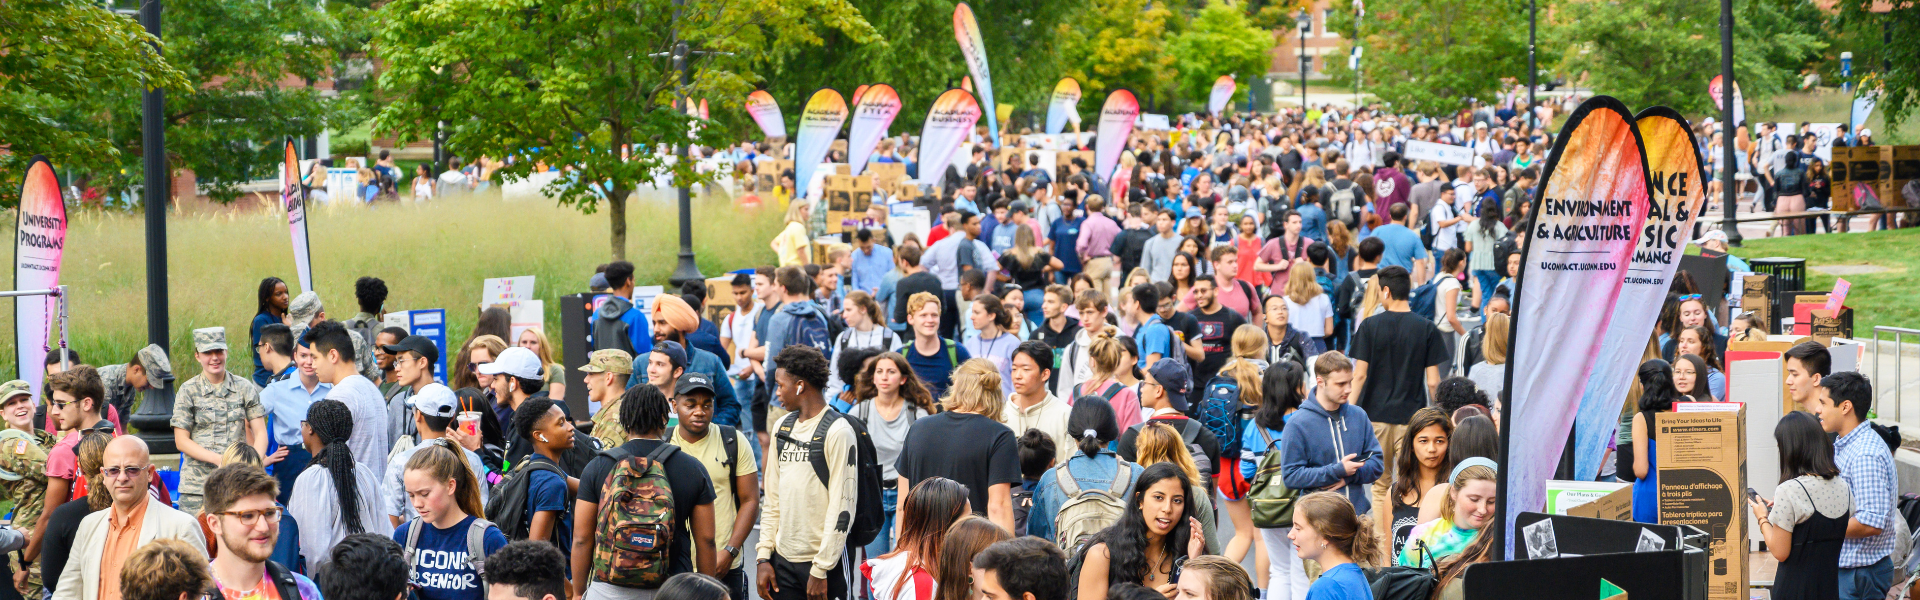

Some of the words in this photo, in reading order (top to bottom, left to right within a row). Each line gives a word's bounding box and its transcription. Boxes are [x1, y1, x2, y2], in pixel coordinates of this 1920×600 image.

[1653, 171, 1688, 196] NCE
[1545, 198, 1632, 217] ENVIRONMENT
[1647, 198, 1671, 221] AL
[1676, 200, 1689, 222] &
[22, 211, 63, 230] UNIVERSITY
[20, 230, 63, 250] PROGRAMS
[1536, 223, 1549, 239] &
[1553, 223, 1631, 241] AGRICULTURE
[1644, 225, 1678, 249] SIC
[1634, 250, 1672, 264] MANCE
[1624, 277, 1664, 285] CT.UCONN.EDU
